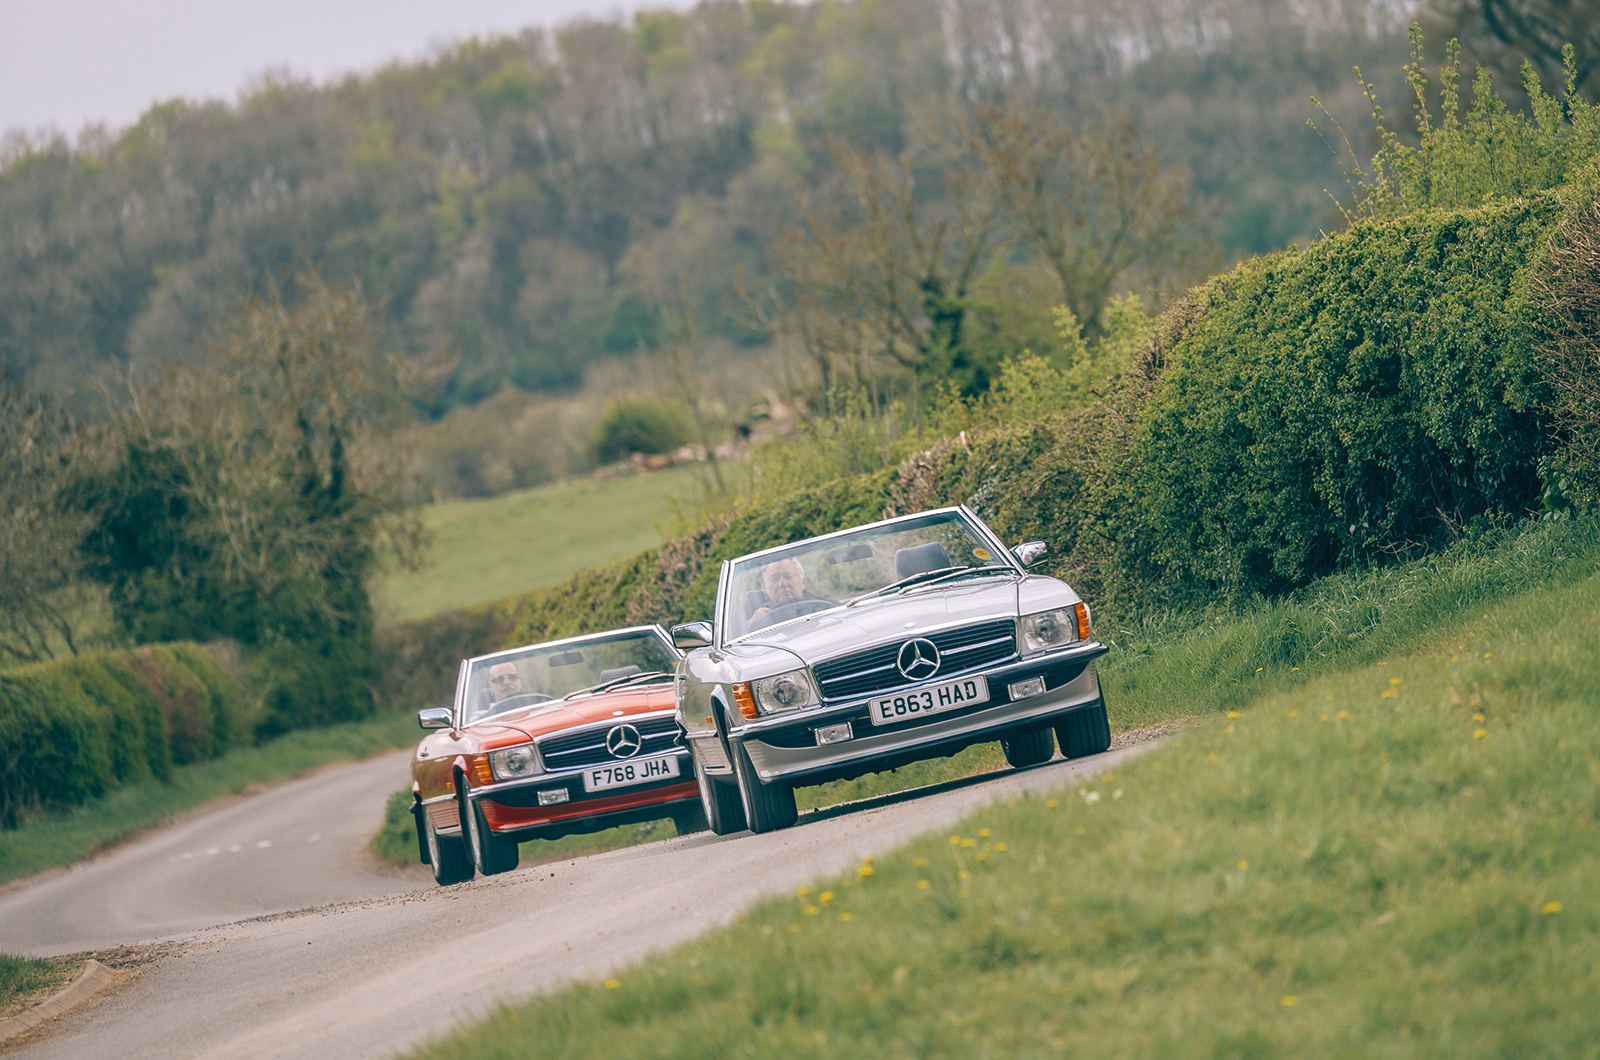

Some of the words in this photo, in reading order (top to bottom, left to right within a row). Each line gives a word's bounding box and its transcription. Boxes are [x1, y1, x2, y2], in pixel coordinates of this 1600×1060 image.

[880, 691, 933, 719] E863
[937, 681, 977, 706] HAD
[592, 765, 635, 786] F768
[640, 759, 671, 778] JHA
